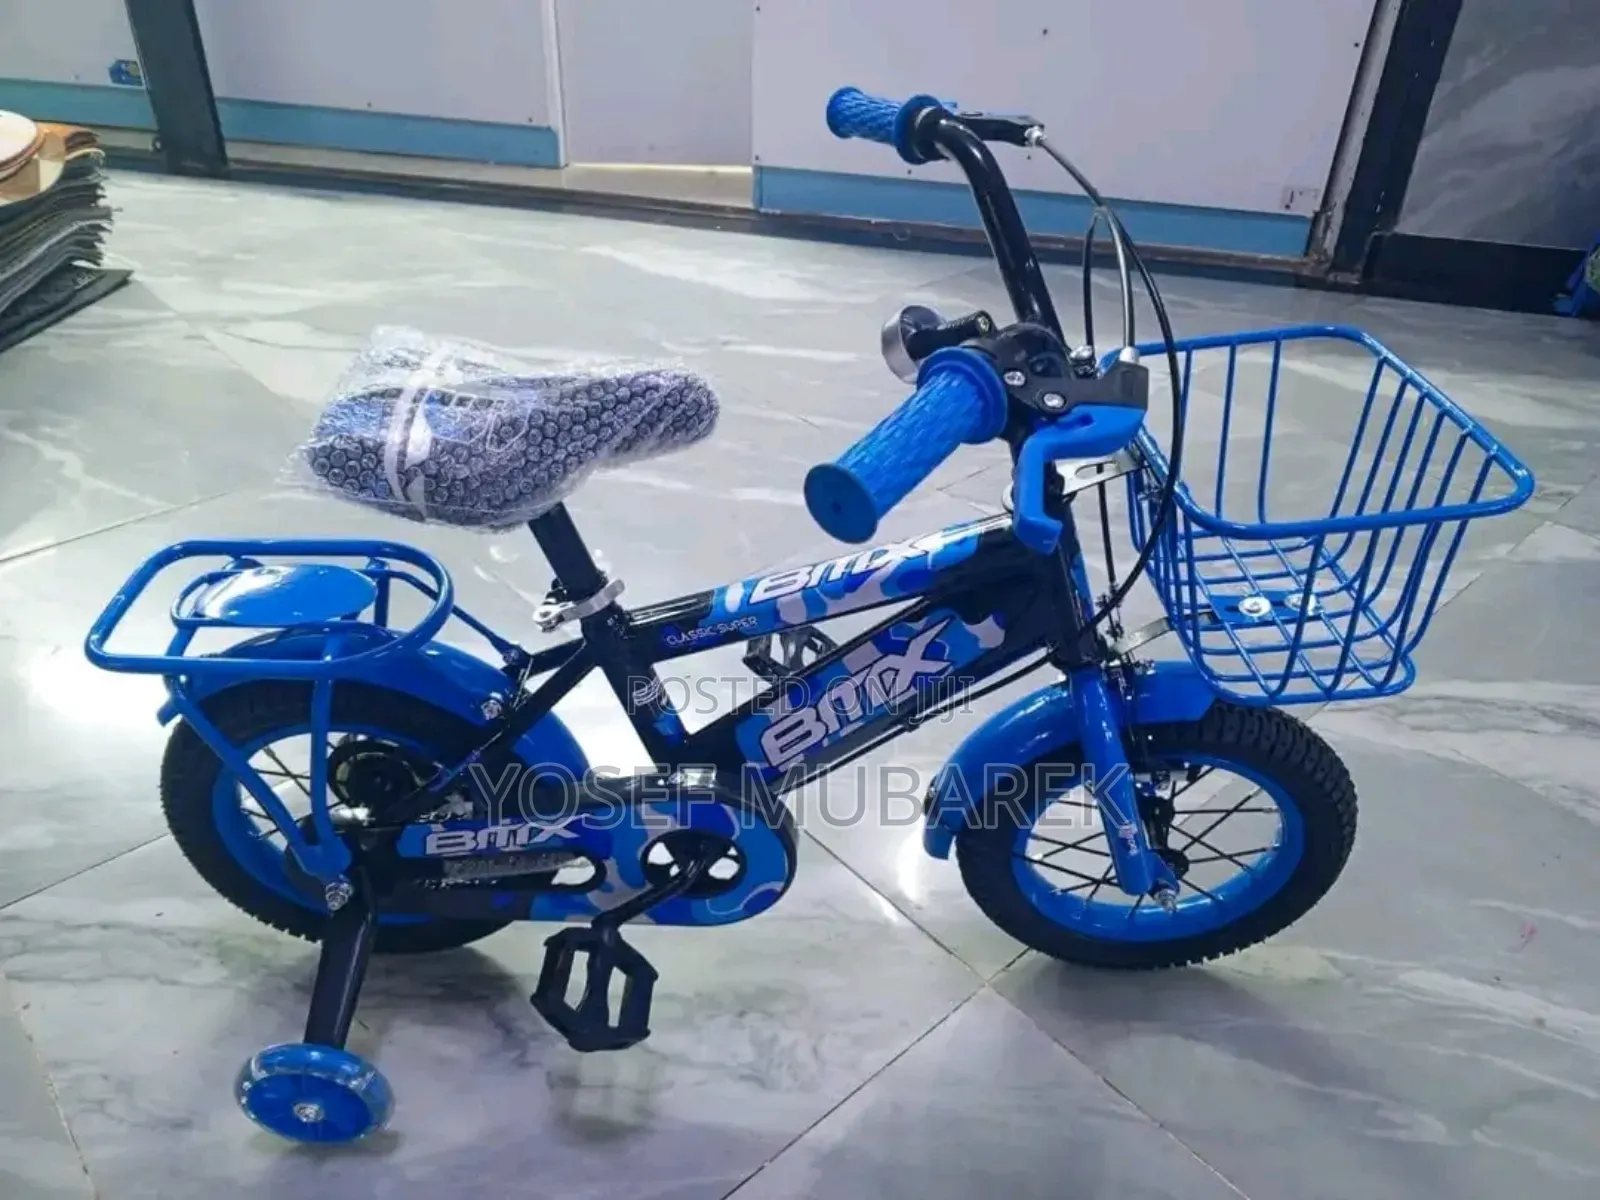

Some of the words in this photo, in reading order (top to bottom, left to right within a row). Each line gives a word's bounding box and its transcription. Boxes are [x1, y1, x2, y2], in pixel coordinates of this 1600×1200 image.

[749, 541, 929, 603] BMX
[665, 626, 717, 645] CLASSIC
[716, 616, 758, 634] SUPER
[761, 615, 951, 768] BMX
[426, 813, 592, 856] BMX
